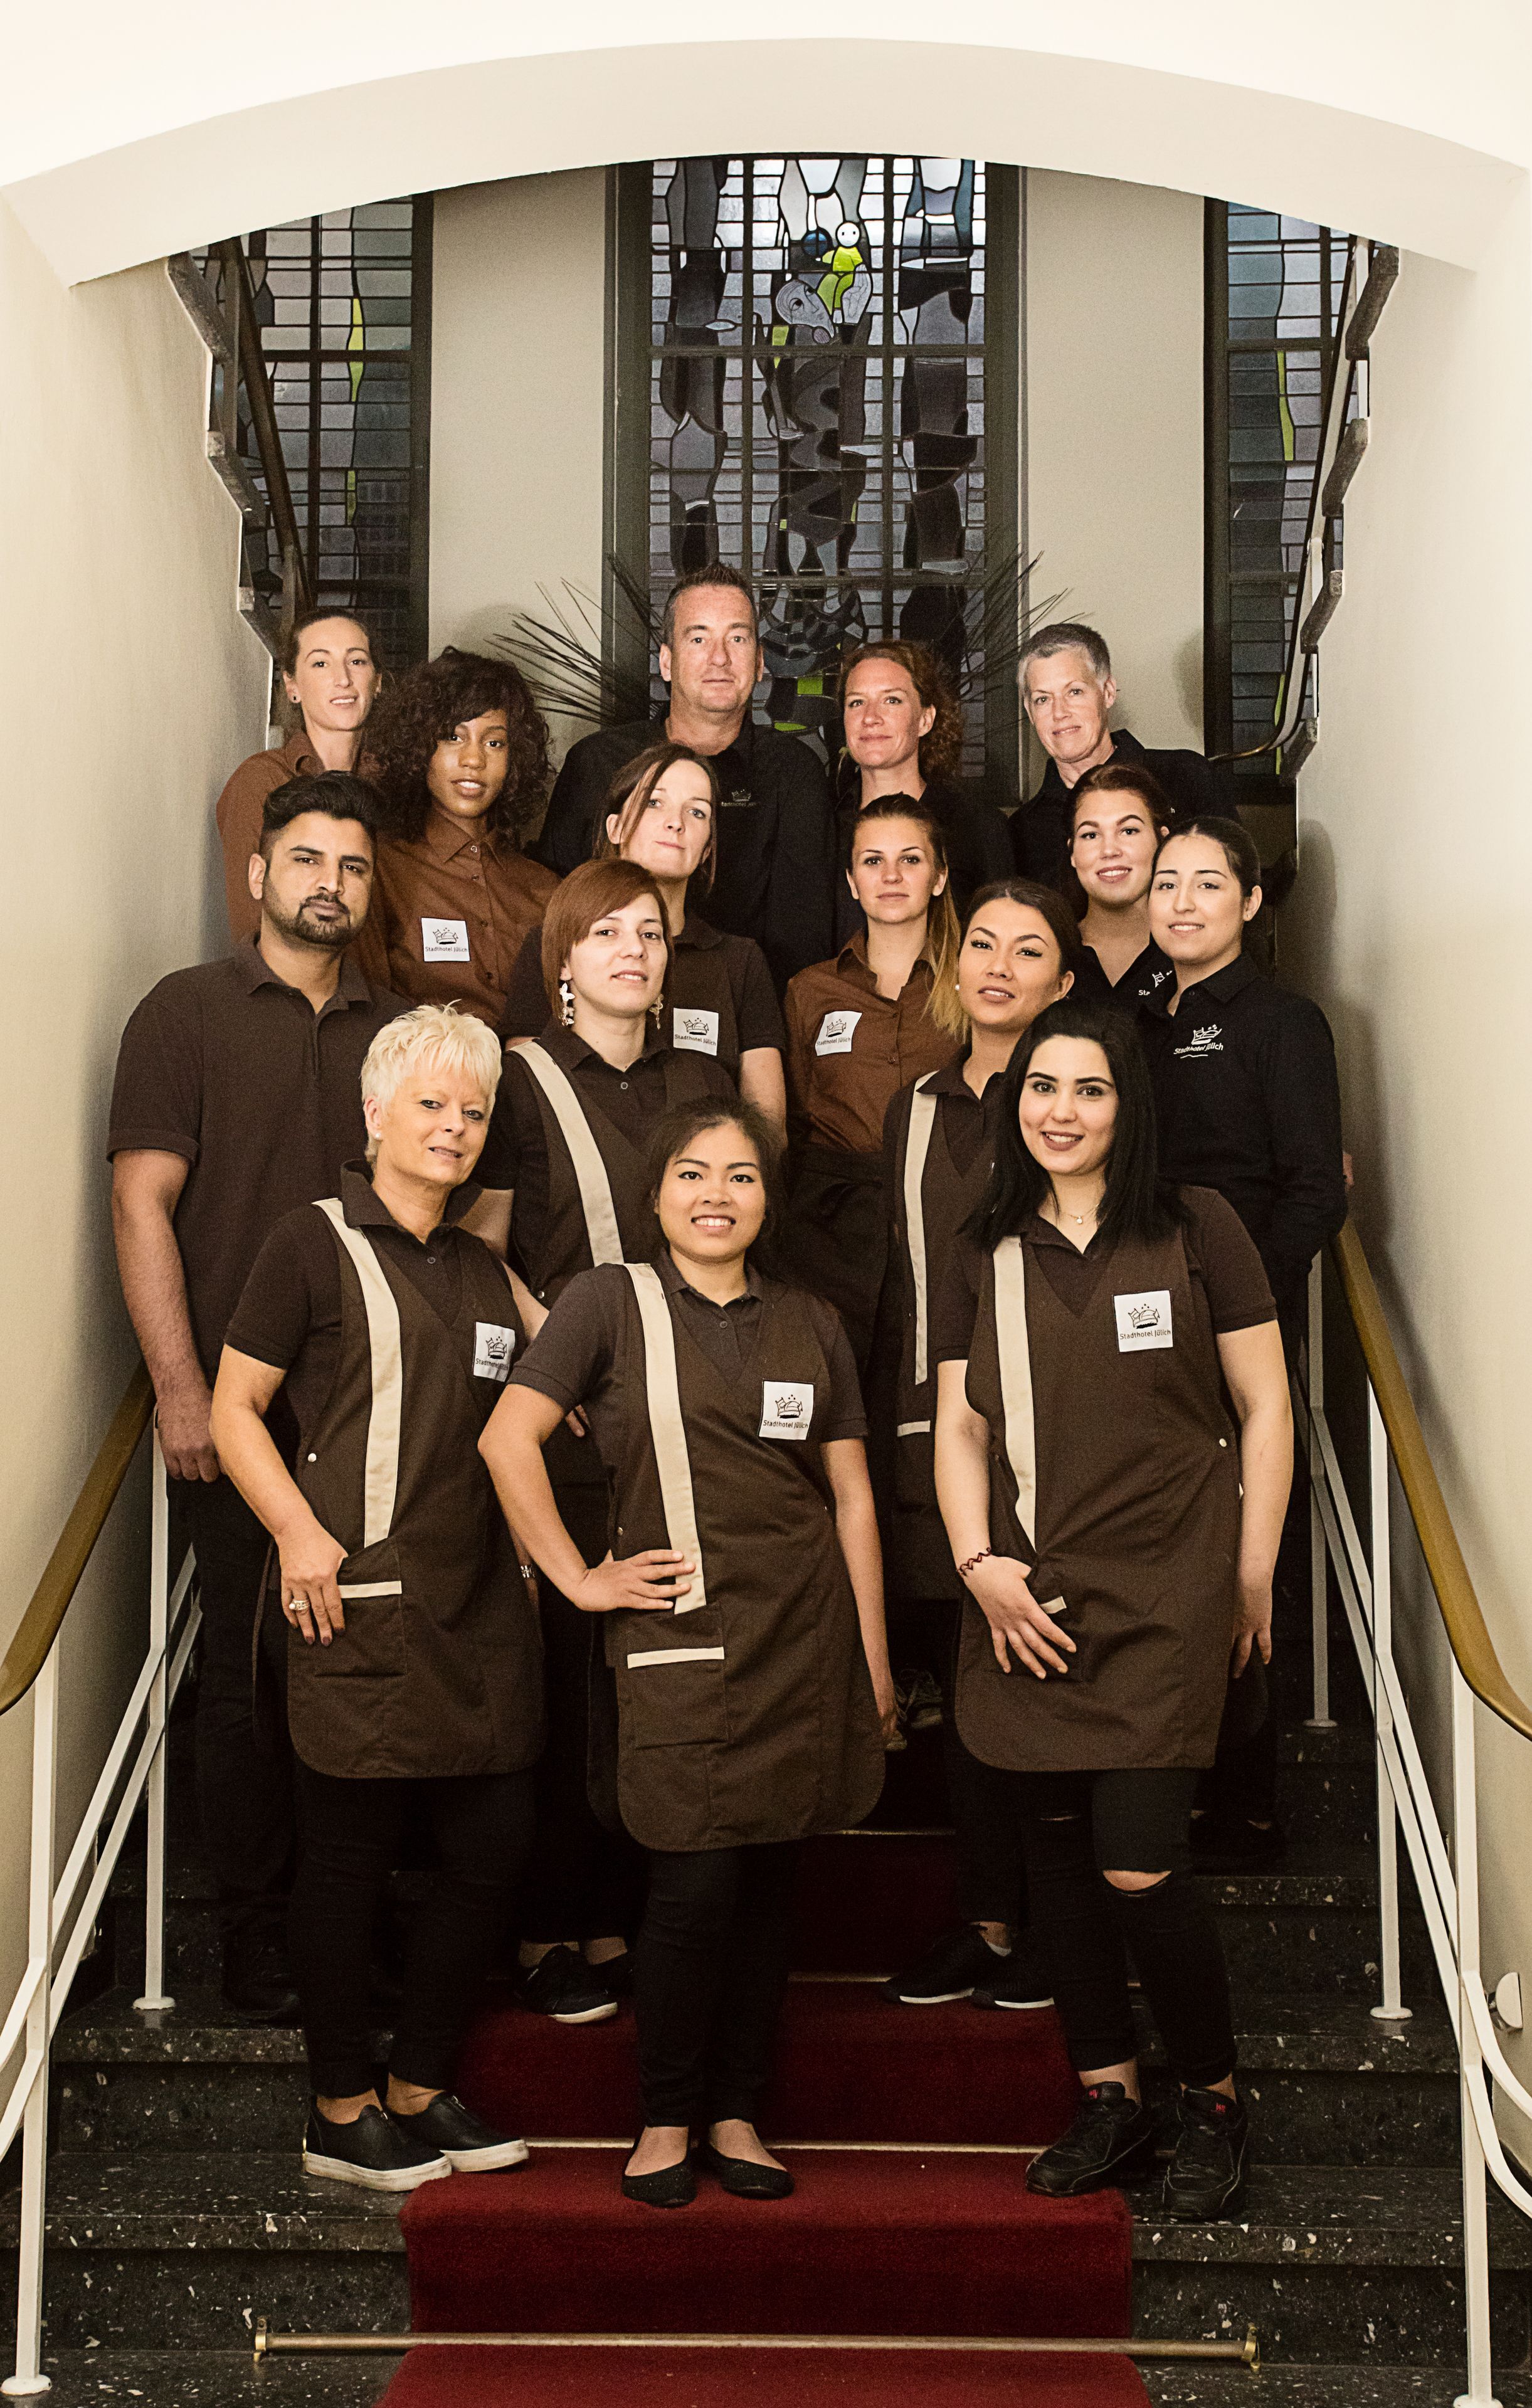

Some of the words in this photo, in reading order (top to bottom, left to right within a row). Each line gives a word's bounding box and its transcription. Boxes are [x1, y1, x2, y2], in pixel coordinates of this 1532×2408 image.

[675, 1034, 702, 1042] Stadthotel
[1173, 1045, 1206, 1054] Stadthotel
[1120, 1331, 1153, 1339] Stadthotel
[1154, 1329, 1171, 1337] Jülich
[763, 1420, 793, 1428] Stadthotel
